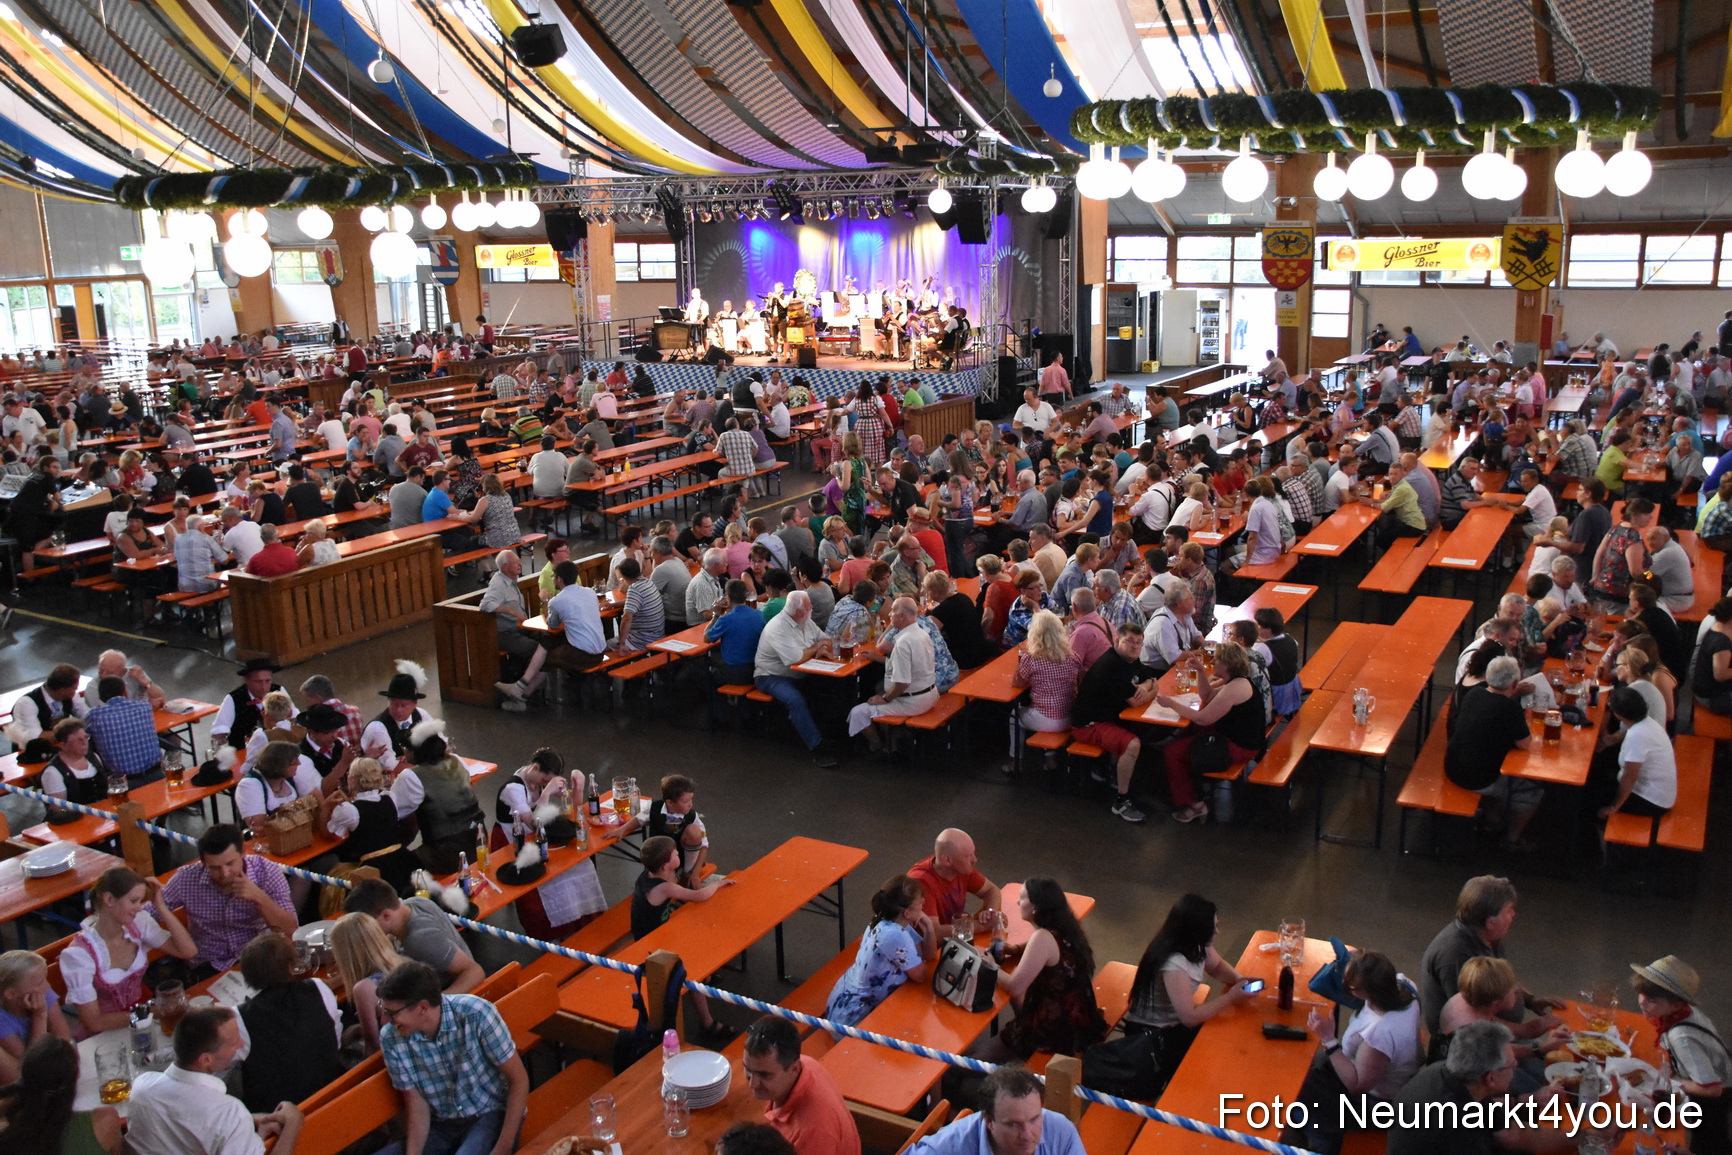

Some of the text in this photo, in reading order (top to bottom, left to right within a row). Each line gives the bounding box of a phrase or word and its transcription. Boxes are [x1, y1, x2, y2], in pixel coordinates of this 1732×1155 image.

[506, 246, 536, 266] Glossner
[1383, 242, 1440, 268] Glossner
[1415, 256, 1440, 268] Bier
